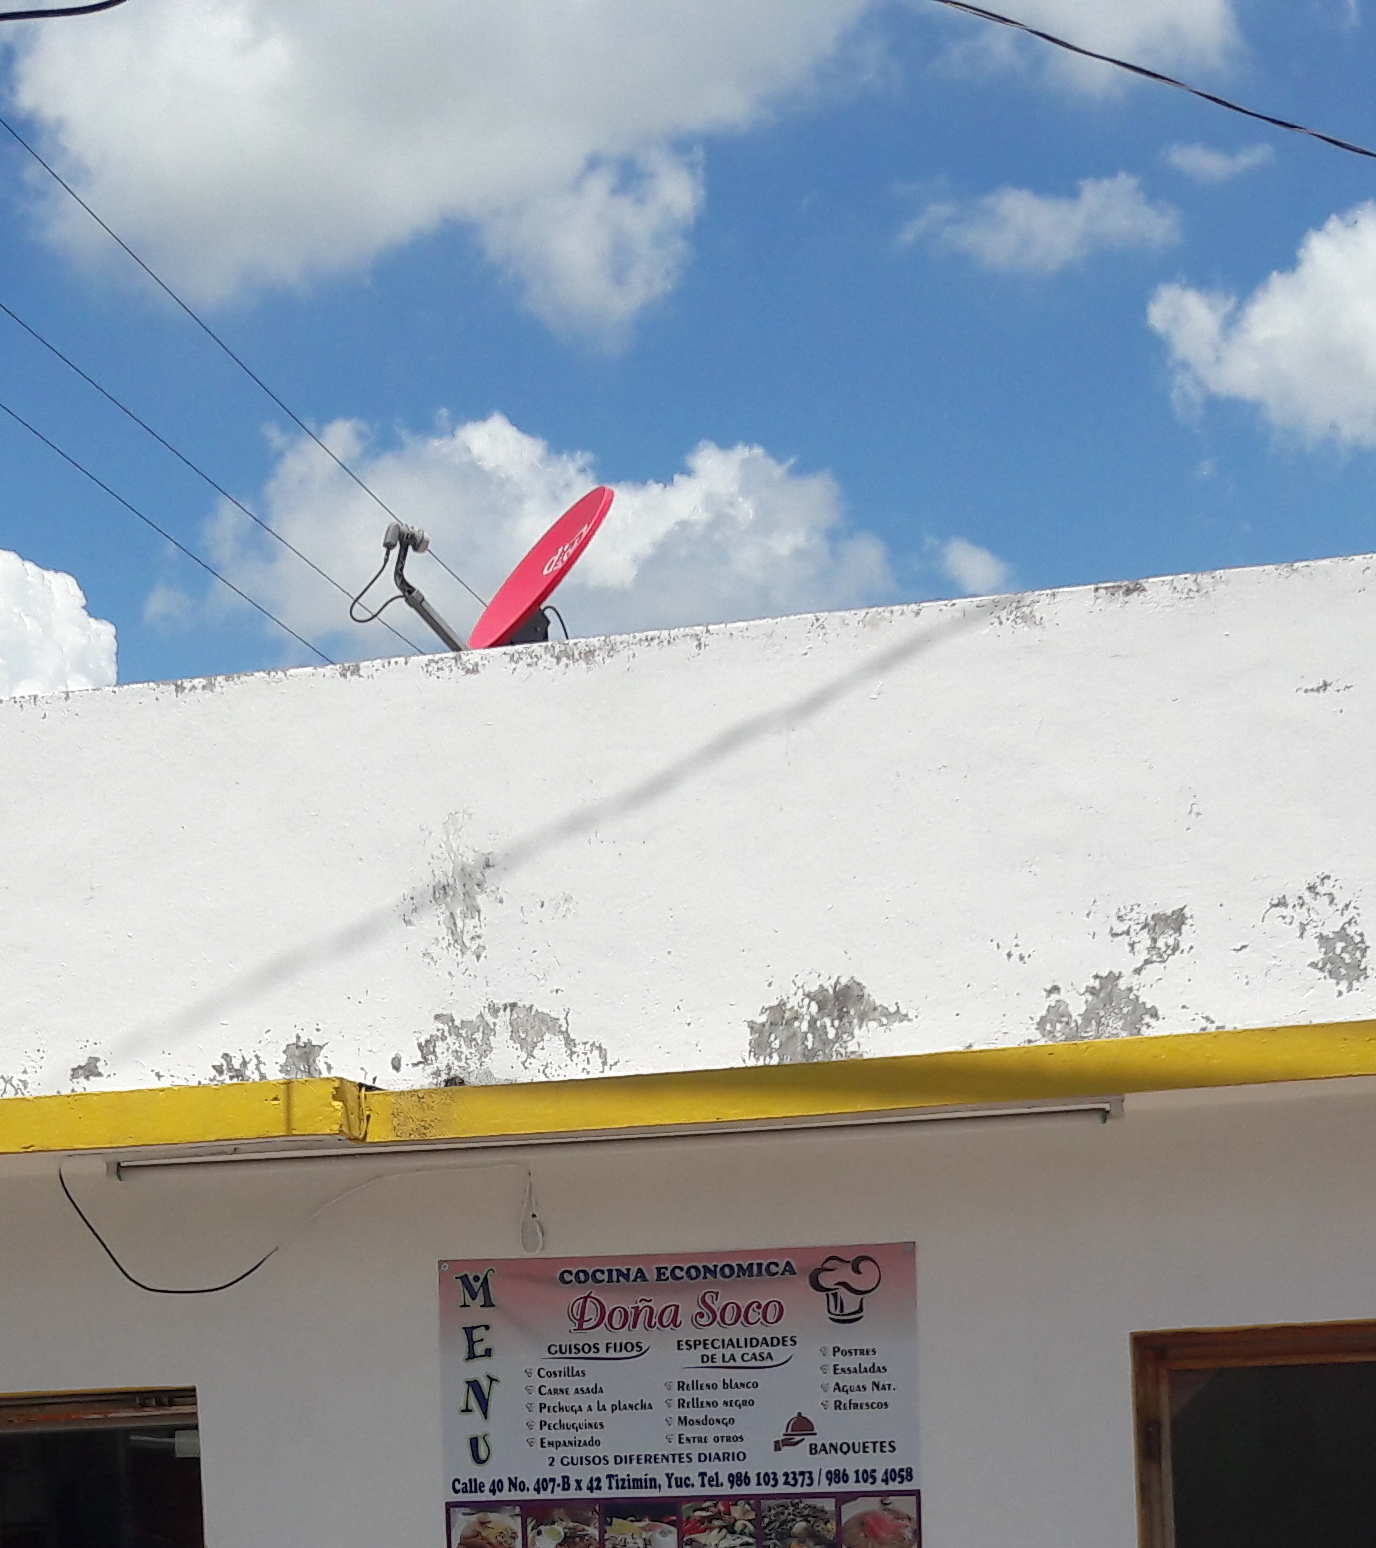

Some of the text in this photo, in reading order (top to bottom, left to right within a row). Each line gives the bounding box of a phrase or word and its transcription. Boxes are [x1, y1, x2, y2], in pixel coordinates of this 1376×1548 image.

[558, 1260, 797, 1285] COCINA ECONOMICA
[567, 1290, 785, 1334] Doña Soco
[547, 1341, 643, 1355] GUISOS FIJOS
[676, 1335, 798, 1351] ESPECIALIDADES
[700, 1351, 774, 1364] DE LA CASA
[832, 1346, 877, 1357] Postres
[537, 1365, 586, 1379] Costillas
[809, 1440, 897, 1456] BANQUETES
[547, 1451, 747, 1467] 2 GUISOS DIFERENTES DIARIO
[451, 1477, 485, 1494] Calle
[488, 1479, 504, 1496] 40
[508, 1476, 530, 1493] No.
[533, 1475, 571, 1495] 407-B
[574, 1479, 583, 1491] x
[586, 1476, 602, 1493] 42
[664, 1471, 695, 1489] Yuc.
[697, 1471, 724, 1488] Tel.
[727, 1471, 751, 1489] 986
[755, 1470, 778, 1488] 103
[782, 1469, 814, 1488] 2373
[825, 1468, 850, 1486] 986
[853, 1467, 877, 1485] 105
[881, 1466, 914, 1485] 4058
